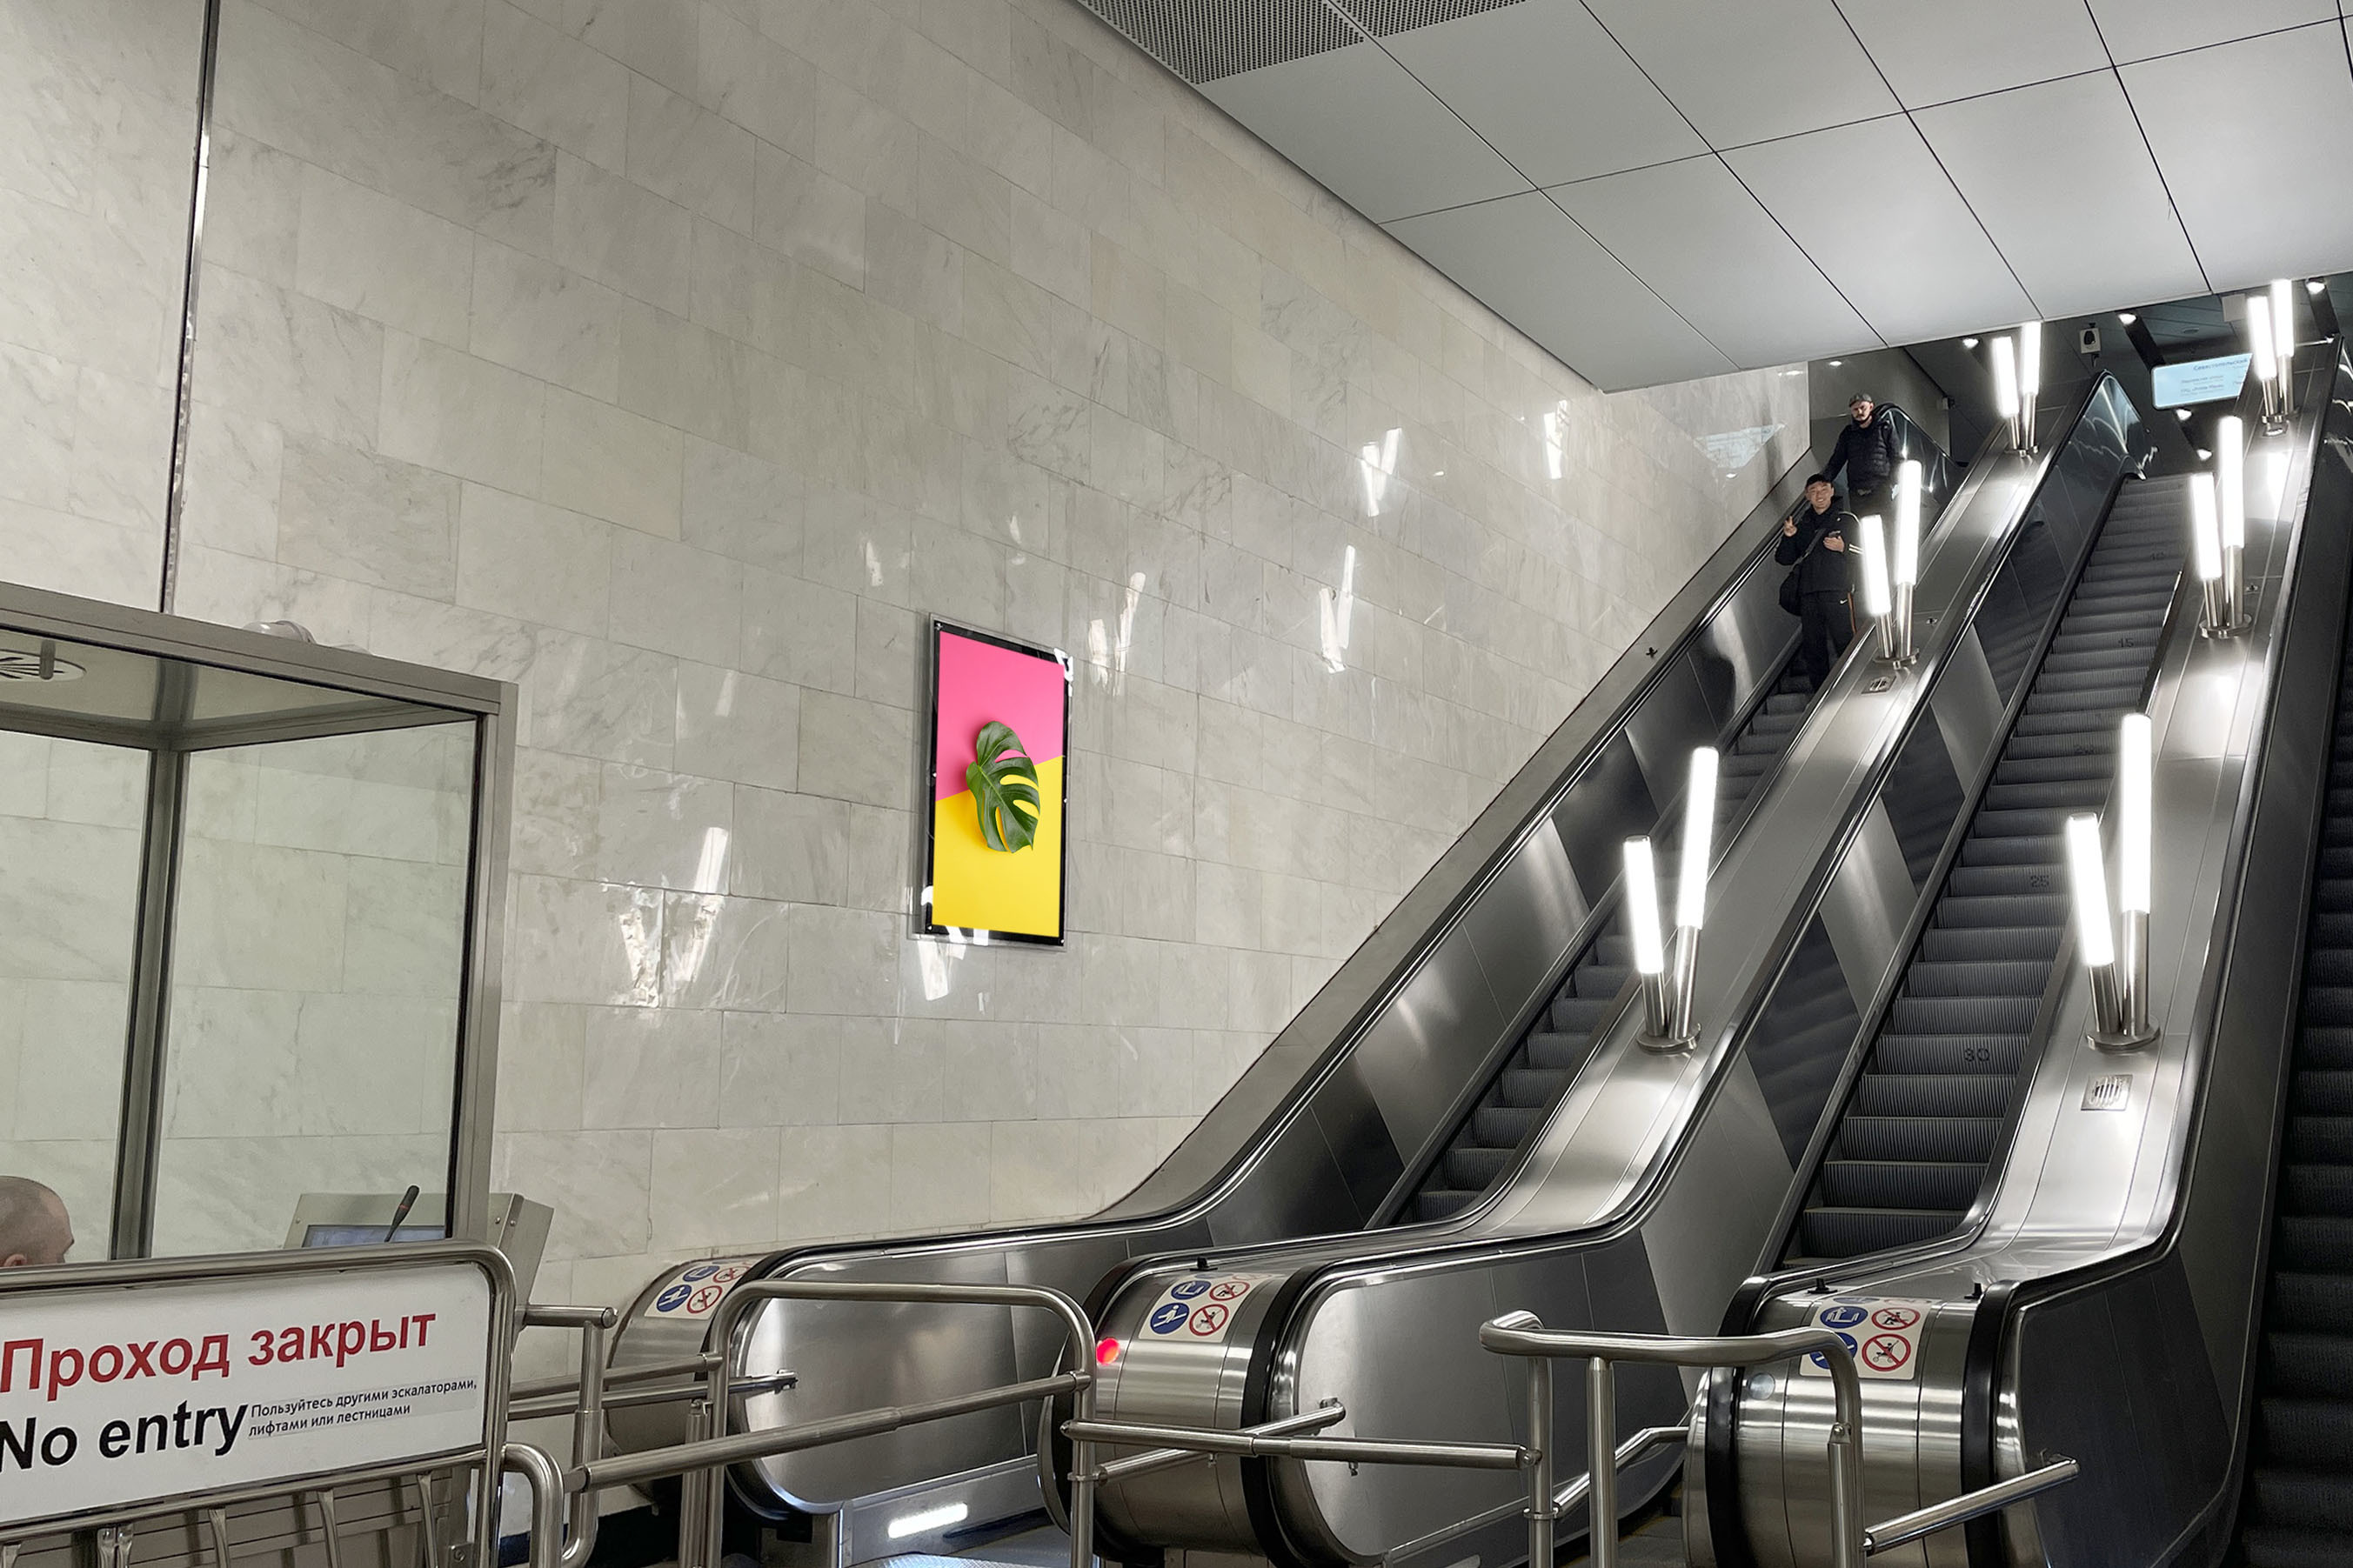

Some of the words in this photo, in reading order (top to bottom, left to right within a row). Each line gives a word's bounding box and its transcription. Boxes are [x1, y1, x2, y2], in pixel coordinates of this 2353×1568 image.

[0, 1334, 230, 1401] Проход
[247, 1313, 436, 1368] закрыт
[249, 1419, 308, 1437] лифтами
[311, 1416, 334, 1427] или
[337, 1405, 411, 1423] лестницами
[251, 1397, 333, 1418] Пользуйтесь
[336, 1391, 389, 1409] другими
[391, 1378, 478, 1398] эскалаторами,
[0, 1417, 77, 1472] No
[99, 1400, 248, 1458] entry
